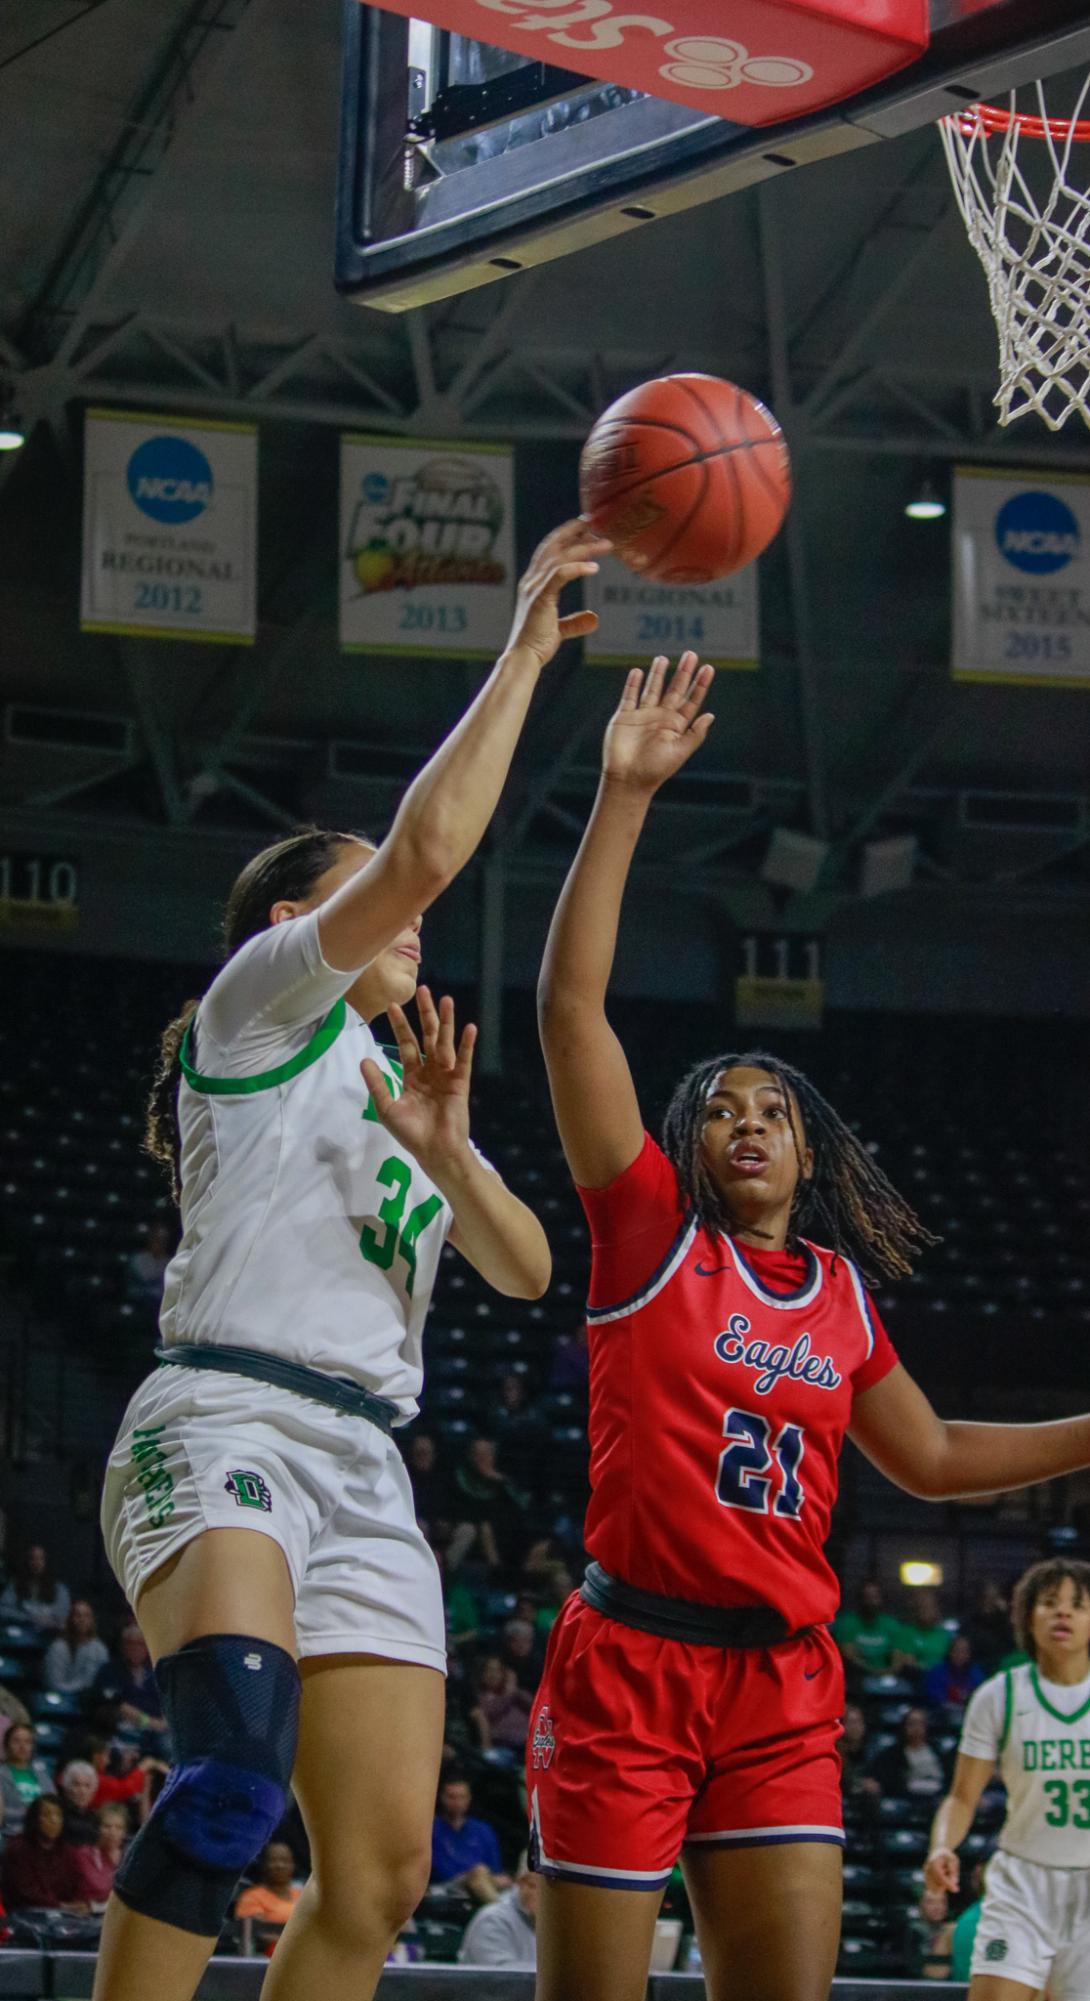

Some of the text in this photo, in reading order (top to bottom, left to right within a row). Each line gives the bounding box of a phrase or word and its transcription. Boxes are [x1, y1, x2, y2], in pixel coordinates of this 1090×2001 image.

[136, 477, 213, 504] NCAA
[389, 479, 489, 519] FINAL
[351, 503, 493, 558] FOUR
[1003, 530, 1080, 557] NCAA
[101, 551, 234, 580] REGIONAL
[134, 580, 204, 614] 2012
[604, 585, 734, 608] REGIONAL
[993, 585, 1082, 607] SWEET
[398, 601, 469, 633] 2013
[637, 613, 705, 641] 2014
[1003, 629, 1073, 660] 2015
[0, 857, 78, 903] 110
[739, 936, 820, 981] 111
[359, 1156, 444, 1300] 34
[714, 1313, 842, 1395] Eagles
[714, 1407, 806, 1522] 21
[1023, 1739, 1090, 1771] DERB
[1043, 1779, 1090, 1829] 33
